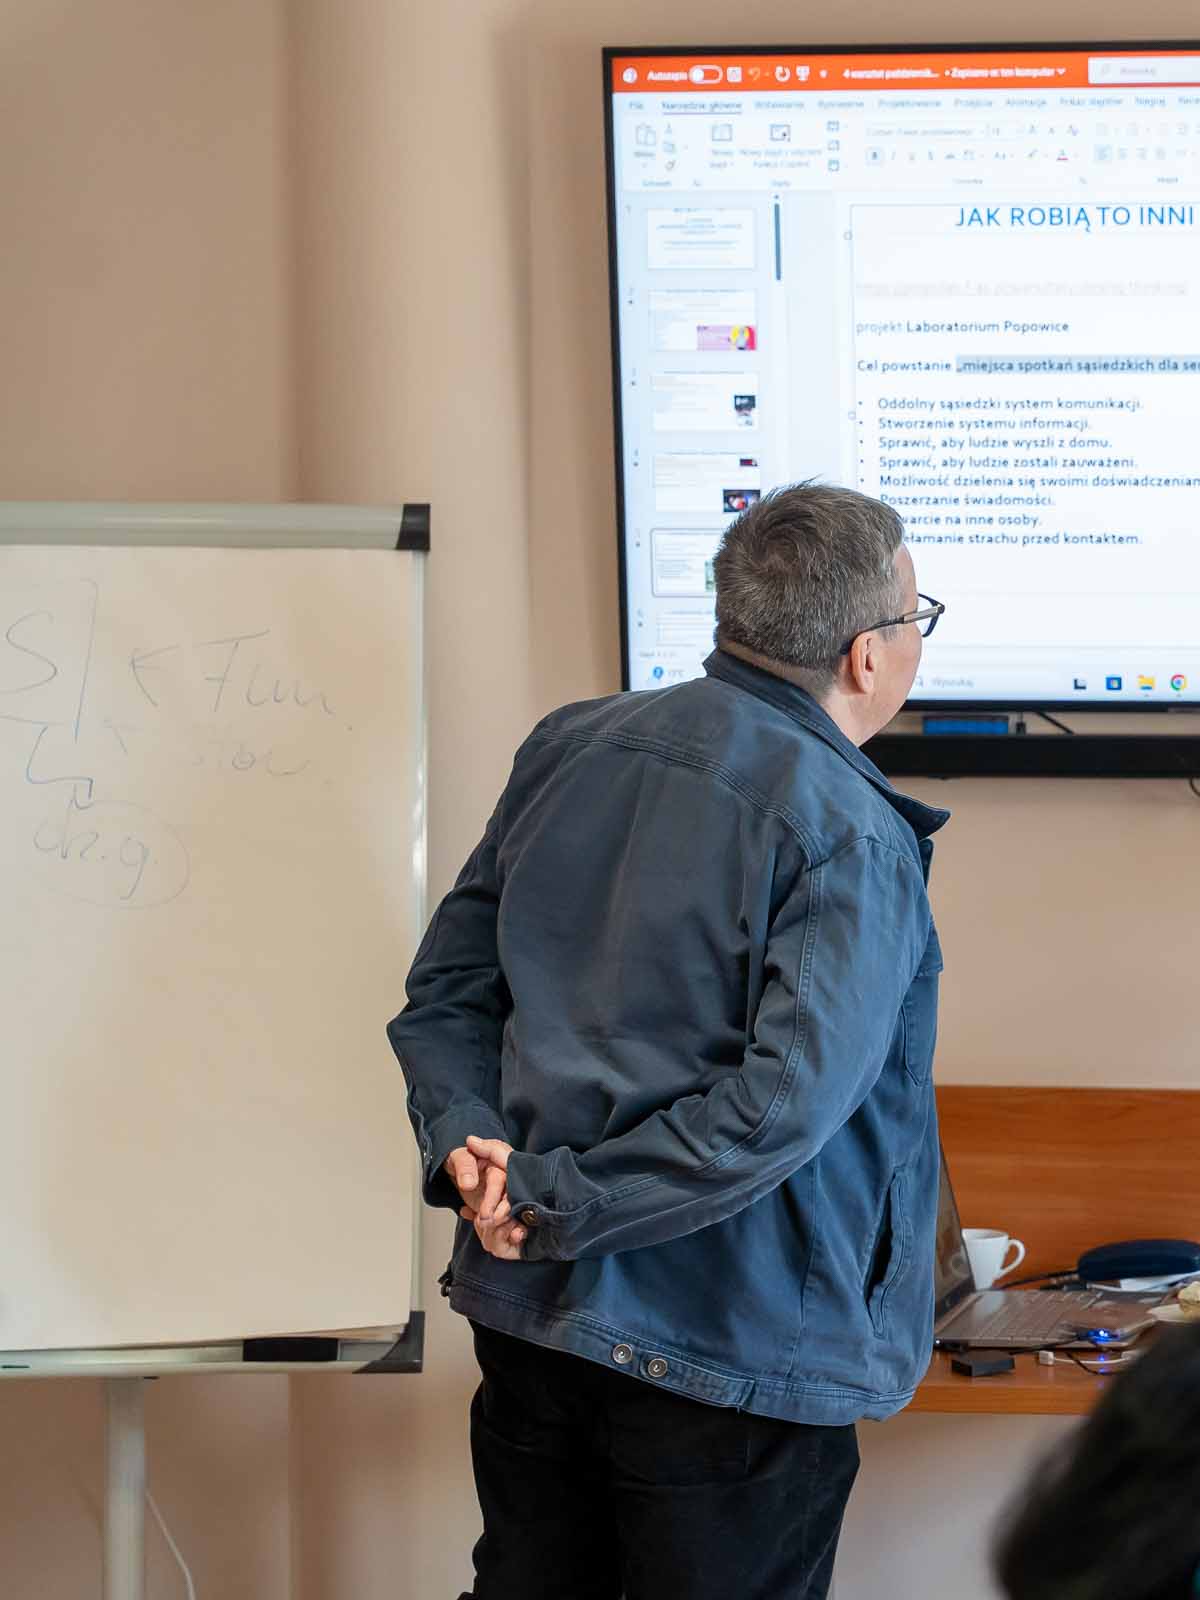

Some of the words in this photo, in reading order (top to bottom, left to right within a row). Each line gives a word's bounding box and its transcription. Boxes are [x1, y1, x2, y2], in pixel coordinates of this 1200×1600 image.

[956, 207, 1000, 226] JAK
[1010, 206, 1091, 232] ROBIĄ
[1095, 206, 1131, 226] TO
[1139, 206, 1193, 225] INNI
[856, 320, 902, 336] projekt
[906, 320, 1000, 333] Laboratorium
[1004, 320, 1070, 336] Popowice
[857, 359, 878, 372] Cel
[882, 361, 952, 375] powstanie
[1018, 358, 1073, 375] spotkań
[1077, 357, 1154, 373] sąsiedzkich
[1158, 358, 1179, 371] dla
[878, 398, 935, 412] Oddolny
[940, 398, 1000, 412] sąsiedzki
[1005, 400, 1053, 411] system
[1057, 398, 1144, 412] komunikacji.
[879, 417, 955, 430] Stworzenie
[959, 418, 1016, 432] systemu
[1020, 416, 1091, 431] informacji.
[941, 437, 965, 451] aby
[969, 436, 1008, 448] ludzie
[1013, 436, 1055, 451] wyszli
[1069, 437, 1112, 448] domu.
[941, 456, 965, 470] aby
[969, 456, 1009, 468] ludzie
[1014, 456, 1058, 468] zostali
[880, 475, 949, 487] Możliwość
[954, 475, 1014, 487] dzielenia
[1018, 475, 1035, 490] się
[1040, 477, 1088, 487] swoimi
[880, 494, 960, 506] Poszerzanie
[945, 516, 961, 525] na
[965, 515, 994, 525] inne
[998, 513, 1042, 528] osoby.
[968, 532, 1018, 544] strachu
[1022, 532, 1060, 547] przed
